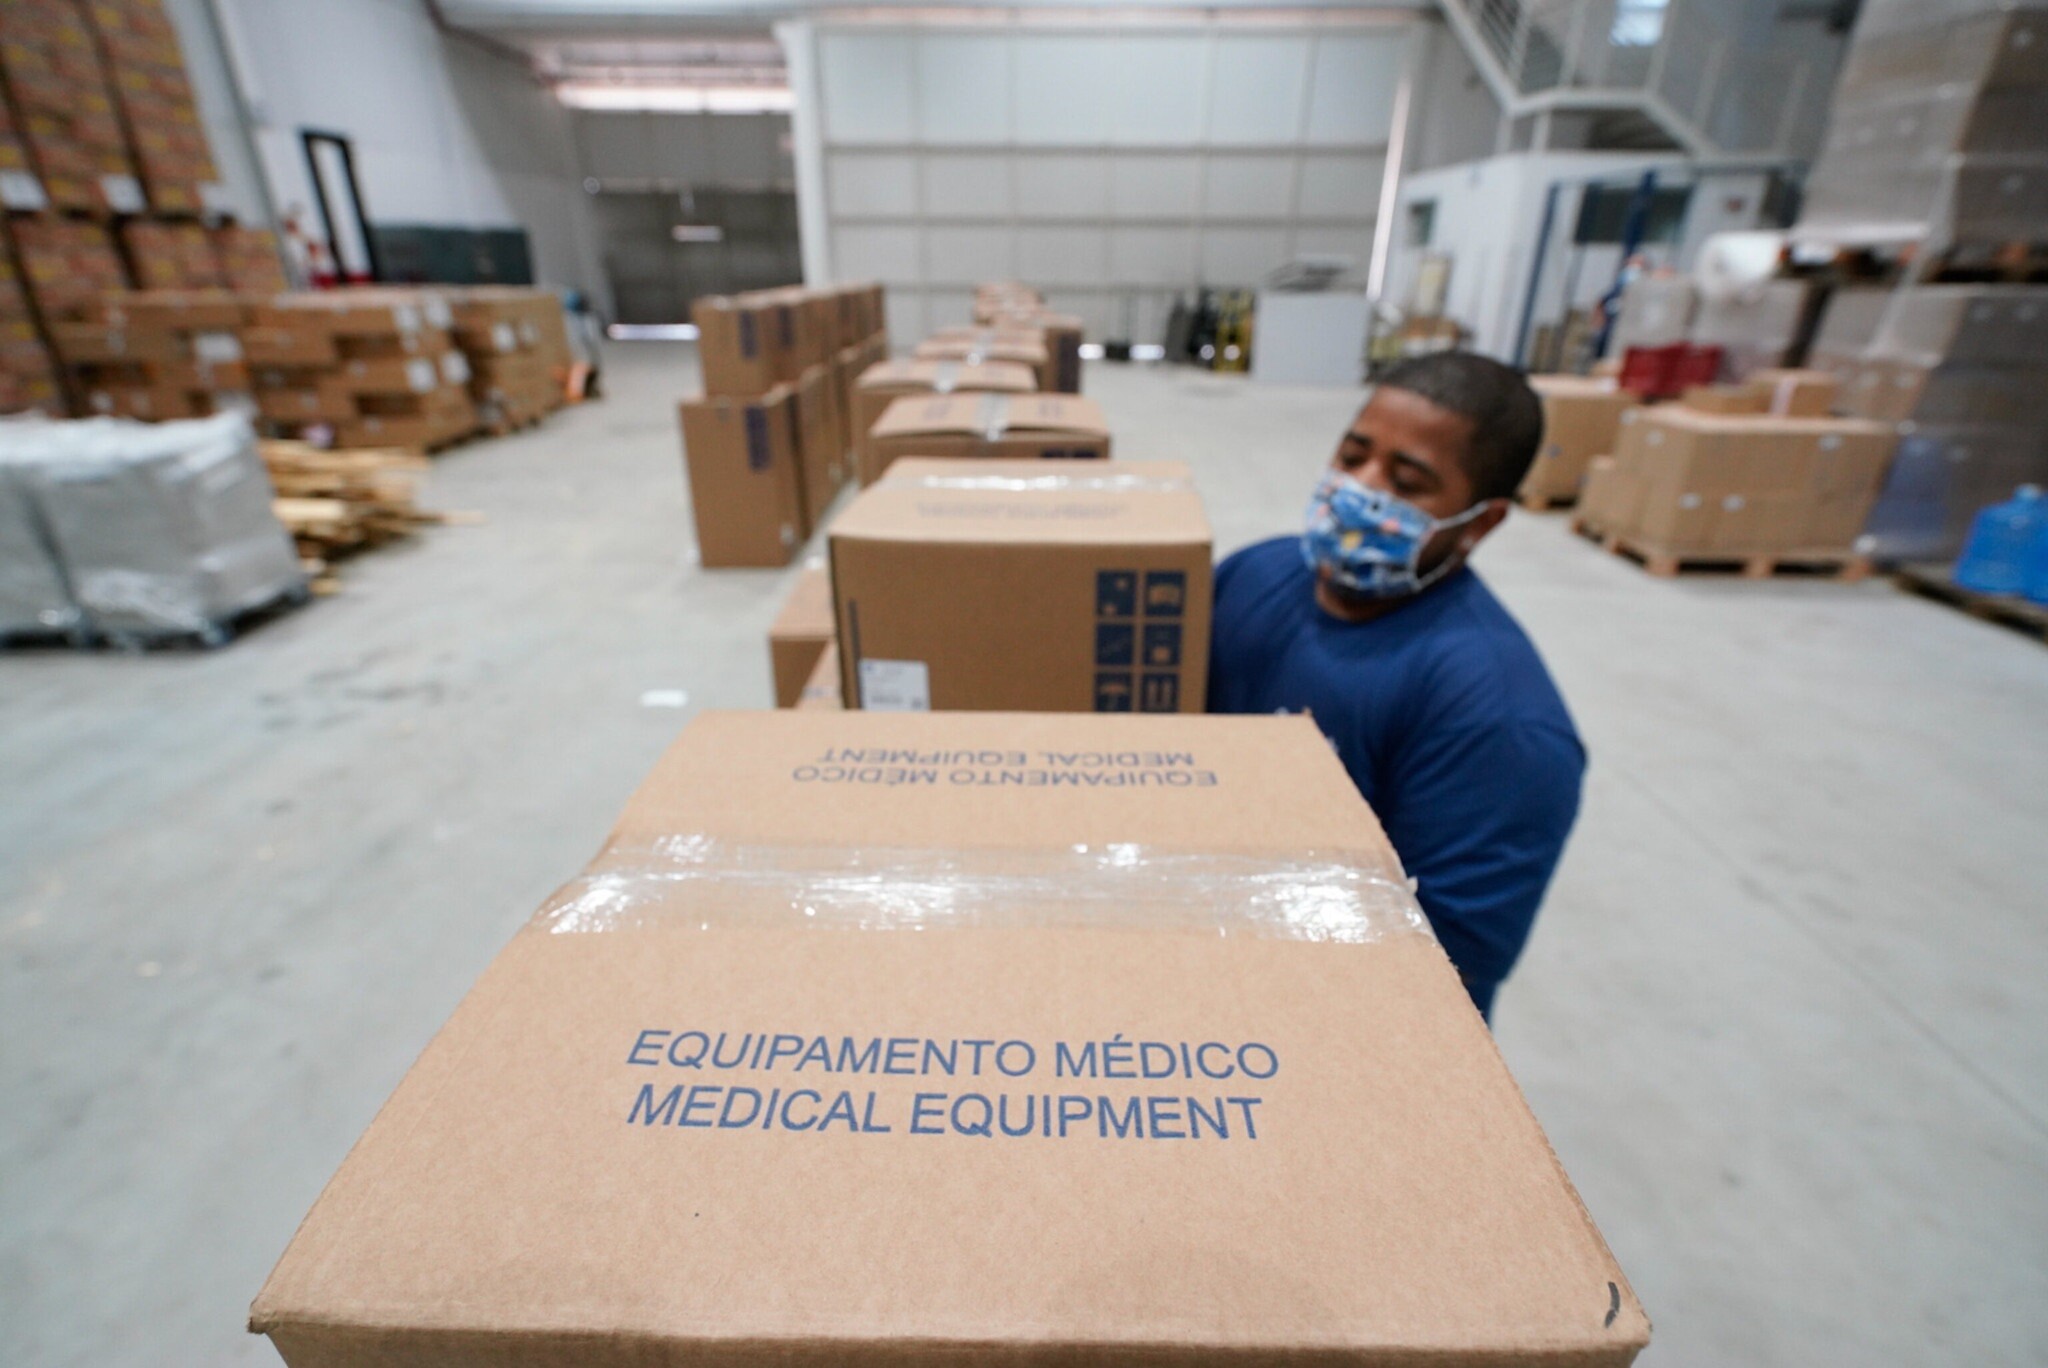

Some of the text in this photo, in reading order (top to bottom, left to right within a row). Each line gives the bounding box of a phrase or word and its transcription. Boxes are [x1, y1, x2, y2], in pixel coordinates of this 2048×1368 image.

[817, 747, 1196, 767] MEDICAL EQUIPMENT
[791, 766, 1218, 787] EQUIPAMENTO MÉDICO
[626, 1029, 1279, 1078] EQUIPAMENTO MÉDICO
[627, 1083, 1262, 1139] MEDICAL EQUIPMENT
